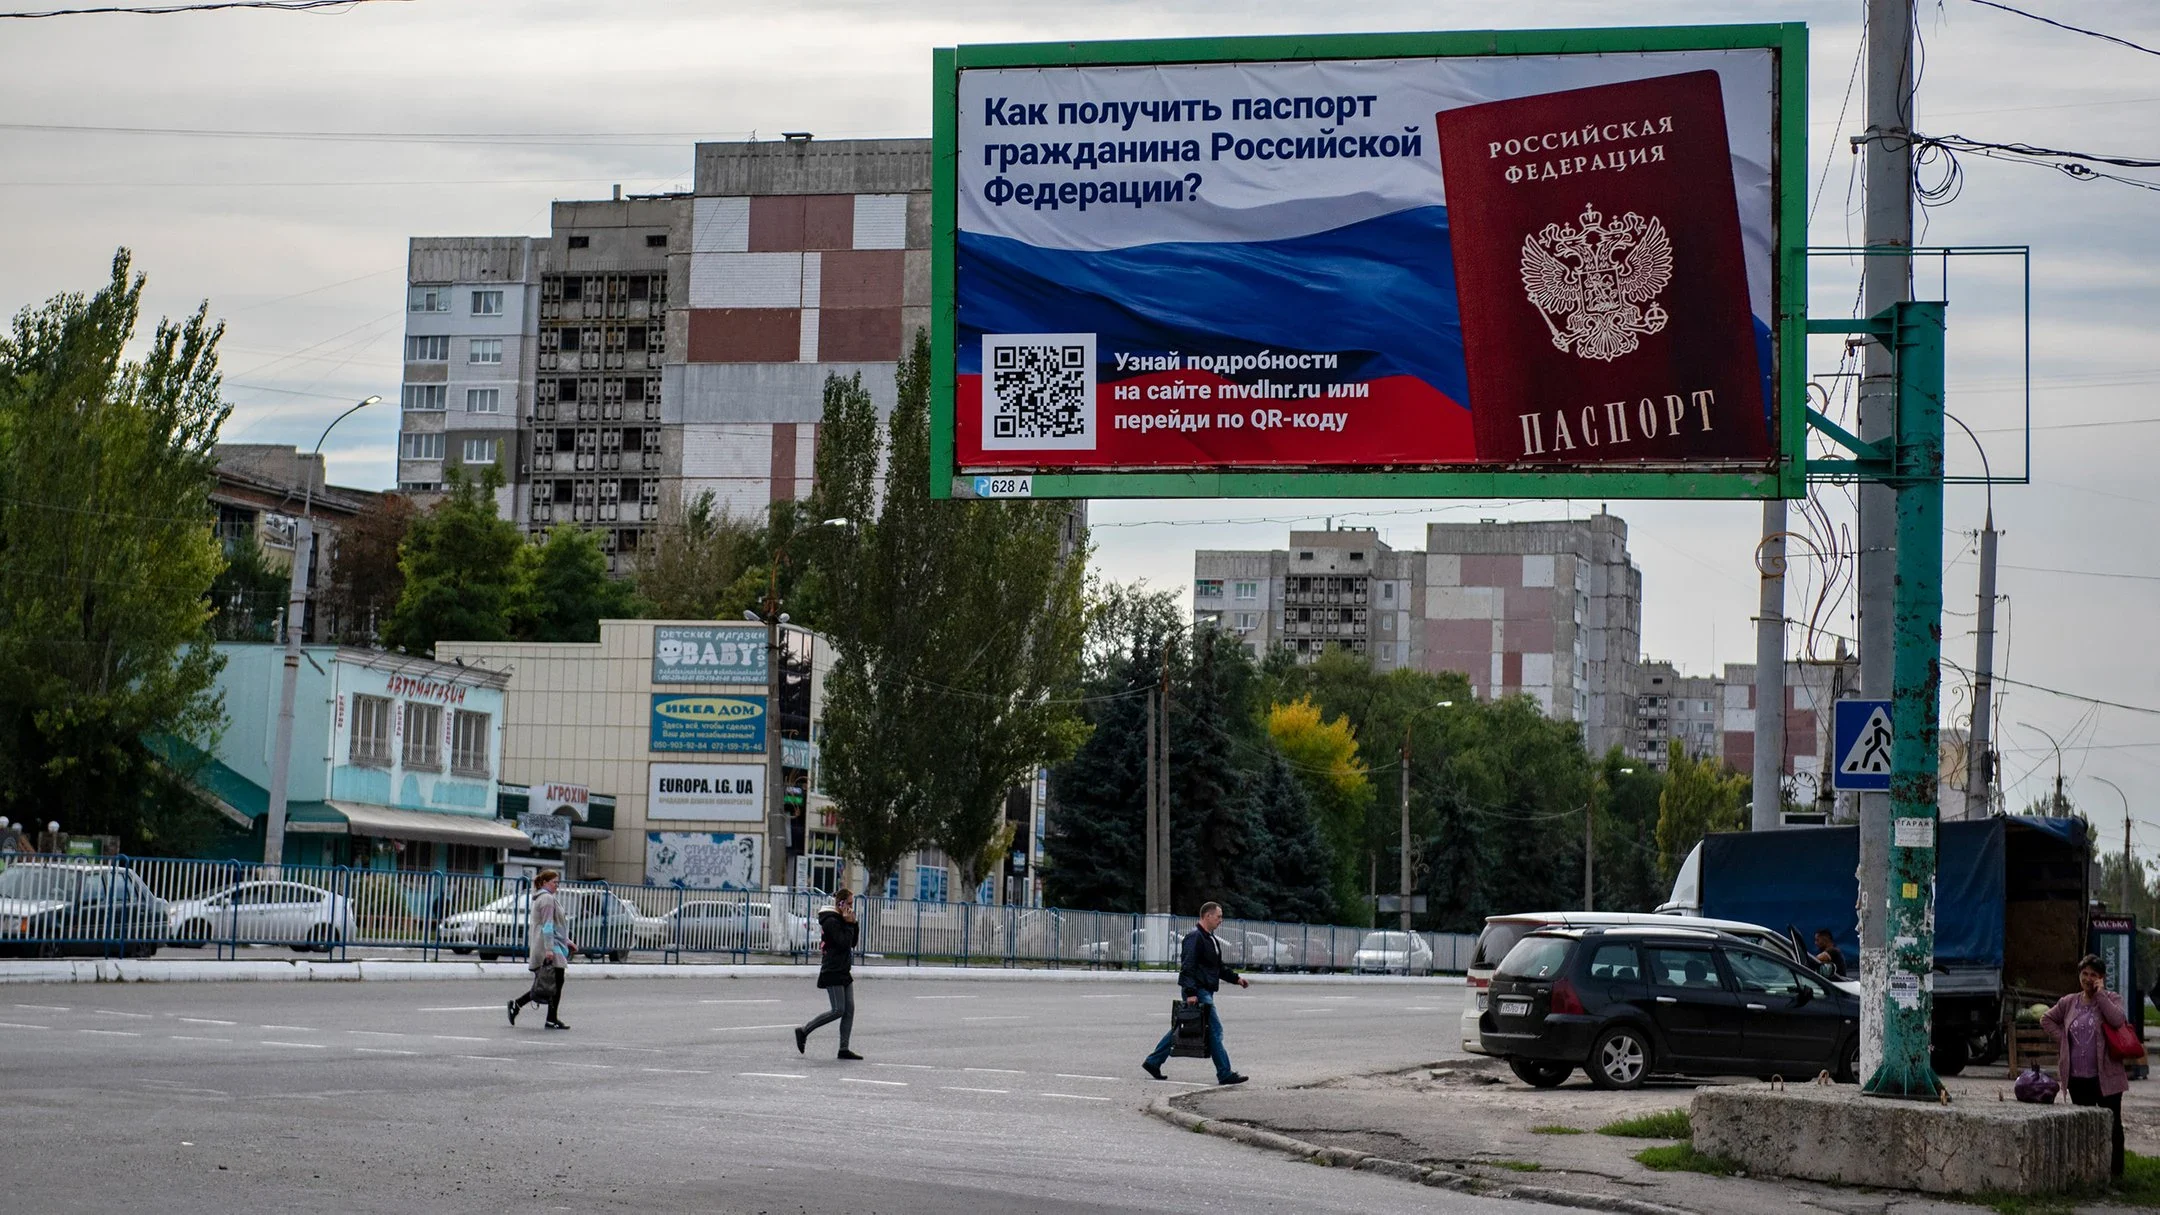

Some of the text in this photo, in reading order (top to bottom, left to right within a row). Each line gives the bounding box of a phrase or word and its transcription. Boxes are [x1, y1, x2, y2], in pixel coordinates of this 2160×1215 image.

[985, 95, 1378, 131] Как получить паспорт
[1488, 115, 1674, 159] РОССИЙСКАЯ
[984, 125, 1422, 174] гражданина Российской
[1504, 144, 1667, 184] ФЕДЕРАЦИЯ
[983, 172, 1203, 211] Федерации?
[1114, 349, 1338, 375] Узнай подробности
[1114, 379, 1369, 400] на сайте mvdlnr.ru или
[1114, 409, 1348, 433] перейди по QR-коду
[1518, 389, 1716, 456] ПАСПОРТ
[991, 479, 1015, 493] 628
[716, 631, 766, 640] МАГАЗИН
[681, 642, 757, 666] BABY
[387, 675, 467, 705] АВТОМАГАЗИН
[665, 704, 755, 716] ИКЕА ДОМ
[662, 721, 684, 730] Здесь
[702, 721, 725, 730] чтобы
[726, 723, 756, 731] сделать
[662, 730, 679, 738] Ваш
[546, 784, 588, 804] АГРОХІМ
[659, 778, 754, 794] EUROPA. LG. UA
[684, 844, 738, 856] СТИЛЬНАЯ
[684, 855, 732, 866] ЖЕНСКАЯ
[683, 865, 728, 877] ОДЕЖДА
[1539, 965, 1549, 976] Z
